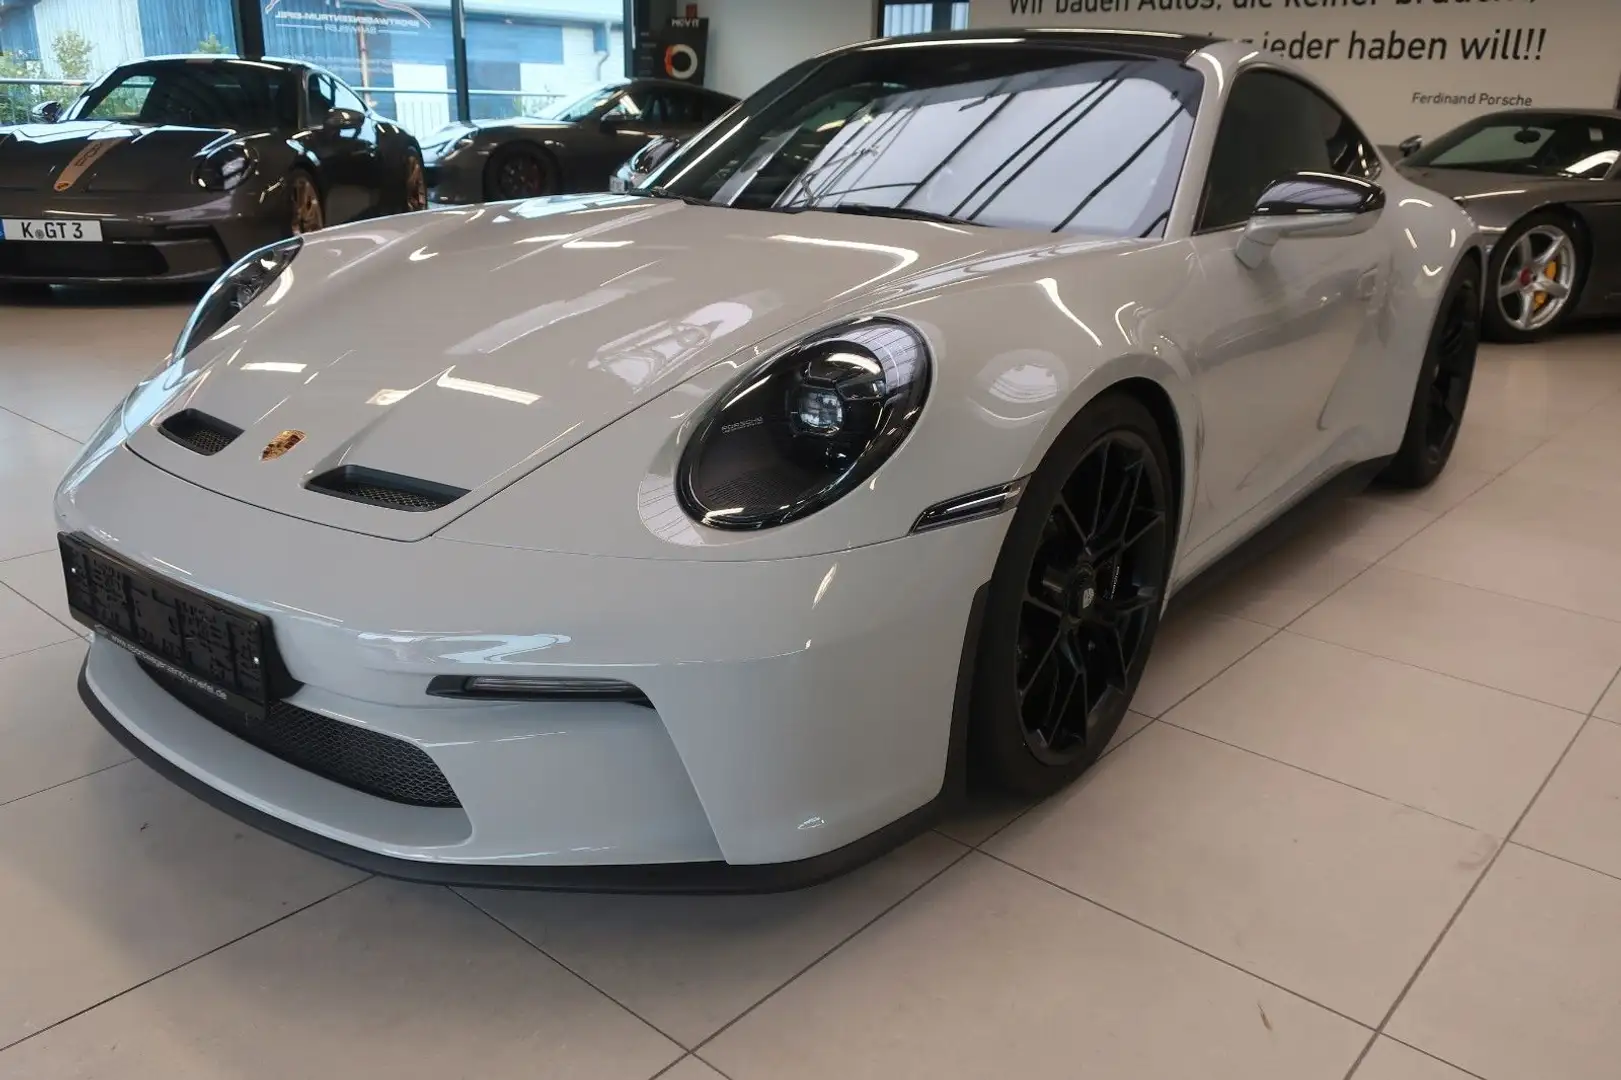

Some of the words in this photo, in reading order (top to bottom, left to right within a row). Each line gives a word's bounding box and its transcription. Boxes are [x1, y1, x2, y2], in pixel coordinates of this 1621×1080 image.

[1347, 30, 1447, 60] haben
[1459, 28, 1546, 61] will!!
[1411, 91, 1476, 105] Ferdinand
[1479, 93, 1533, 107] Porsche
[21, 221, 34, 239] K
[72, 222, 83, 239] 3
